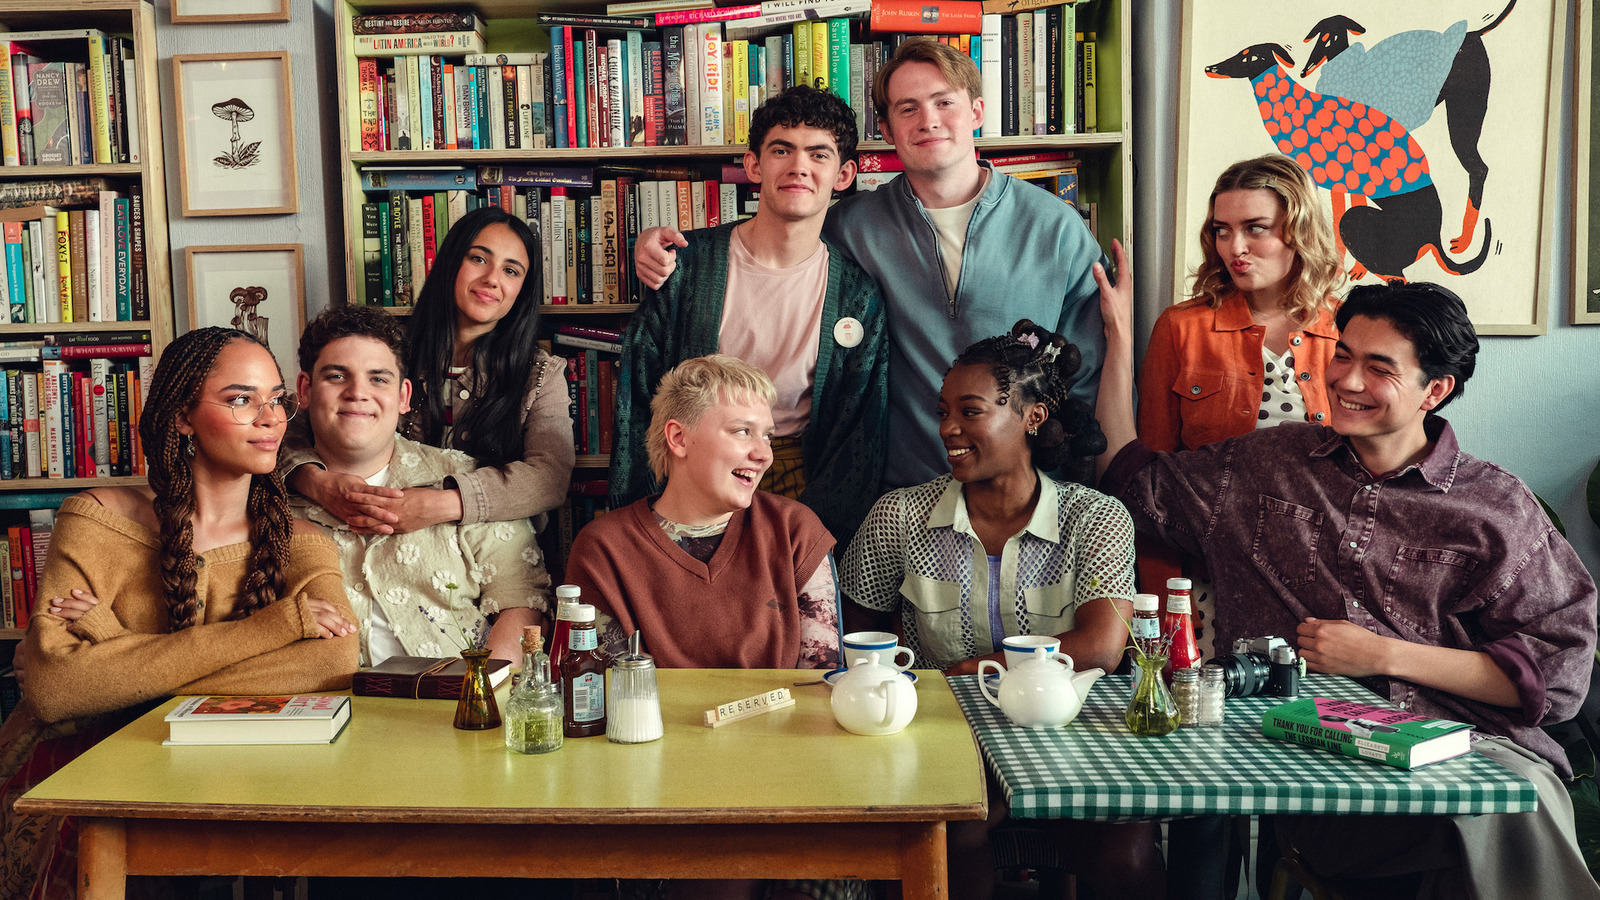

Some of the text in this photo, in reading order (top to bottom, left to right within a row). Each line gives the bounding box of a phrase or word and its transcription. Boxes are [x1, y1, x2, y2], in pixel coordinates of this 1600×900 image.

[374, 38, 422, 50] LATIN AMERICA
[554, 44, 563, 63] Birds
[670, 36, 678, 48] the
[706, 33, 718, 58] JOY
[1022, 20, 1030, 67] Bloomsbury
[652, 50, 661, 94] BECOMING
[667, 52, 680, 69] Map
[462, 85, 470, 100] DAN
[556, 71, 564, 94] Winter
[669, 83, 680, 105] Chaos
[852, 76, 862, 113] CLOSER
[364, 118, 377, 126] END
[705, 107, 713, 132] LAHR
[1059, 182, 1076, 195] THE
[680, 188, 688, 216] HUCK
[424, 203, 432, 233] Tomato
[553, 200, 562, 242] Enter Ghost
[58, 230, 67, 263] FOXY-T
[27, 377, 35, 397] FOOD
[93, 364, 104, 416] REQUIEM
[719, 690, 784, 717] RESERVED
[1273, 718, 1352, 744] THANK YOU FOR CALLING
[1284, 731, 1342, 752] THE LESBIAN LINE
[1357, 740, 1389, 751] ELIZABETH
[1361, 749, 1382, 758] LOVATT
